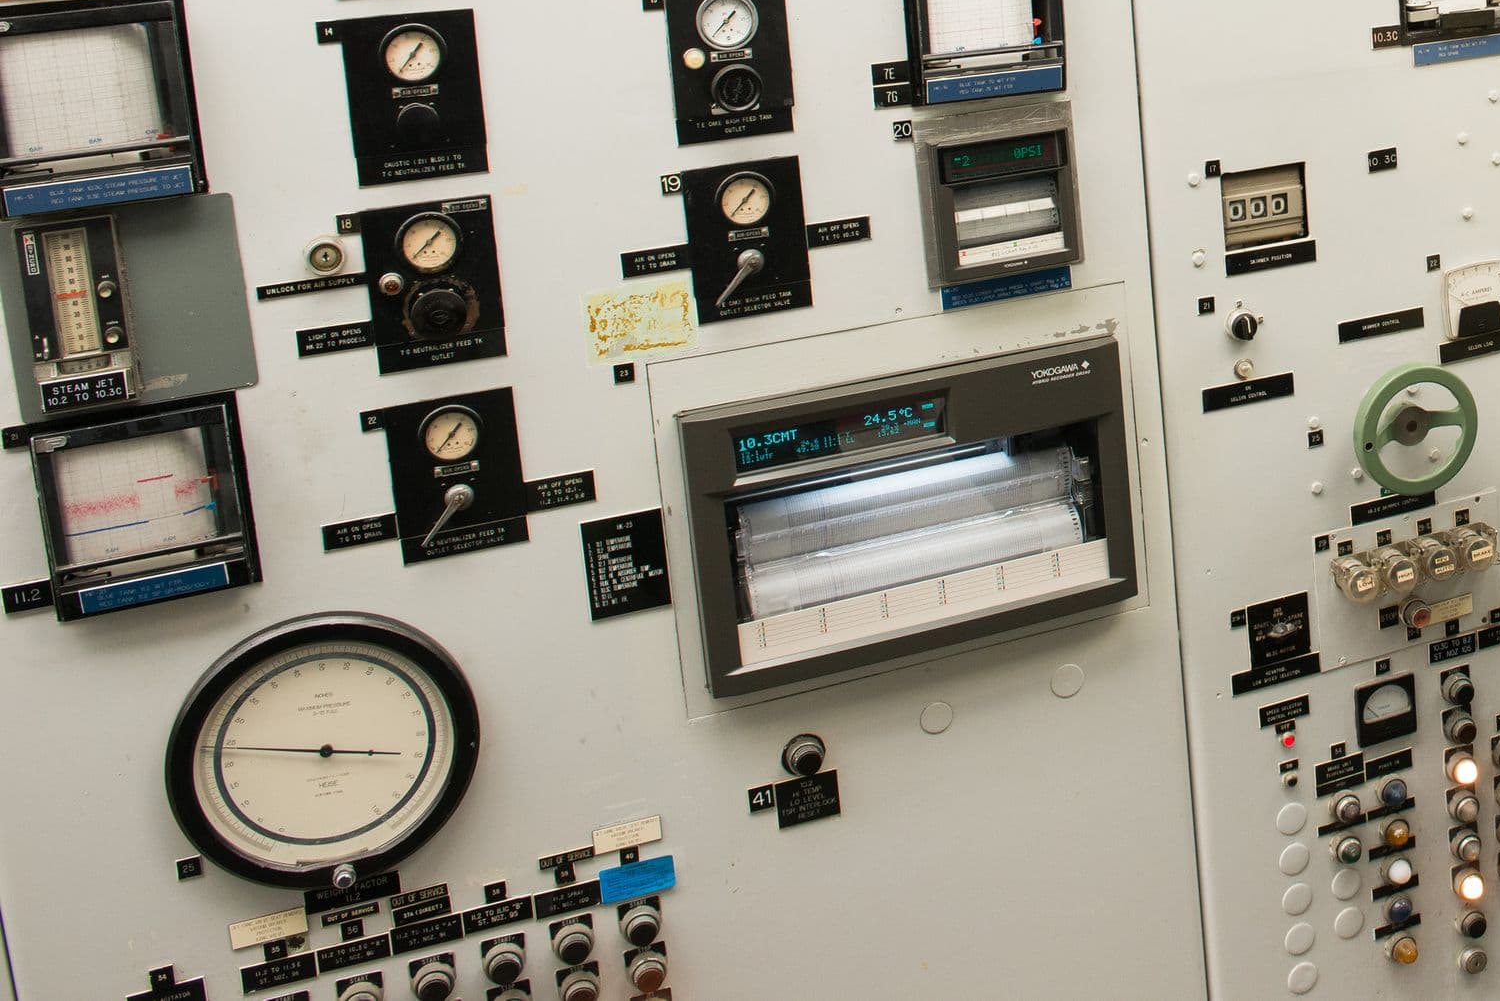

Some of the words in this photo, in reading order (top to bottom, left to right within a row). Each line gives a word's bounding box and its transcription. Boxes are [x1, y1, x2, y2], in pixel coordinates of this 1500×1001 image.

[1373, 30, 1399, 43] 10.3C
[884, 68, 896, 80] 7E
[886, 90, 898, 103] 7G
[725, 125, 747, 134] OUTLET
[893, 122, 911, 137] 20
[384, 160, 410, 169] CAUSTIC
[394, 166, 436, 176] NEUTRALIZER
[439, 163, 455, 171] FEED
[661, 175, 681, 193] 19
[341, 217, 352, 229] 18
[1250, 257, 1270, 265] SKIMMER
[1271, 253, 1292, 261] POSITION
[266, 285, 294, 295] UNLOCK
[297, 282, 312, 291] FOR
[314, 280, 326, 289] AIR
[328, 277, 355, 287] SUPPLY
[308, 332, 327, 341] LIGHT
[342, 327, 362, 336] OPENS
[338, 335, 366, 345] PROCESS
[431, 352, 455, 362] OUTLET
[1031, 362, 1078, 380] YOKOGAWA
[52, 381, 89, 396] STEAM
[95, 378, 115, 389] JET
[47, 396, 68, 407] 10.2
[75, 392, 90, 401] TO
[95, 386, 122, 399] 10.3C
[368, 416, 377, 424] 22
[739, 428, 798, 452] 10.3CMT
[1358, 579, 1373, 589] LOW
[752, 789, 772, 806] 41
[540, 858, 554, 870] OUT
[556, 855, 565, 866] OF
[567, 849, 593, 863] SERVICE
[181, 863, 195, 874] 25
[354, 879, 388, 892] FACTOR
[407, 894, 417, 903] OF
[420, 886, 446, 900] SERVICE
